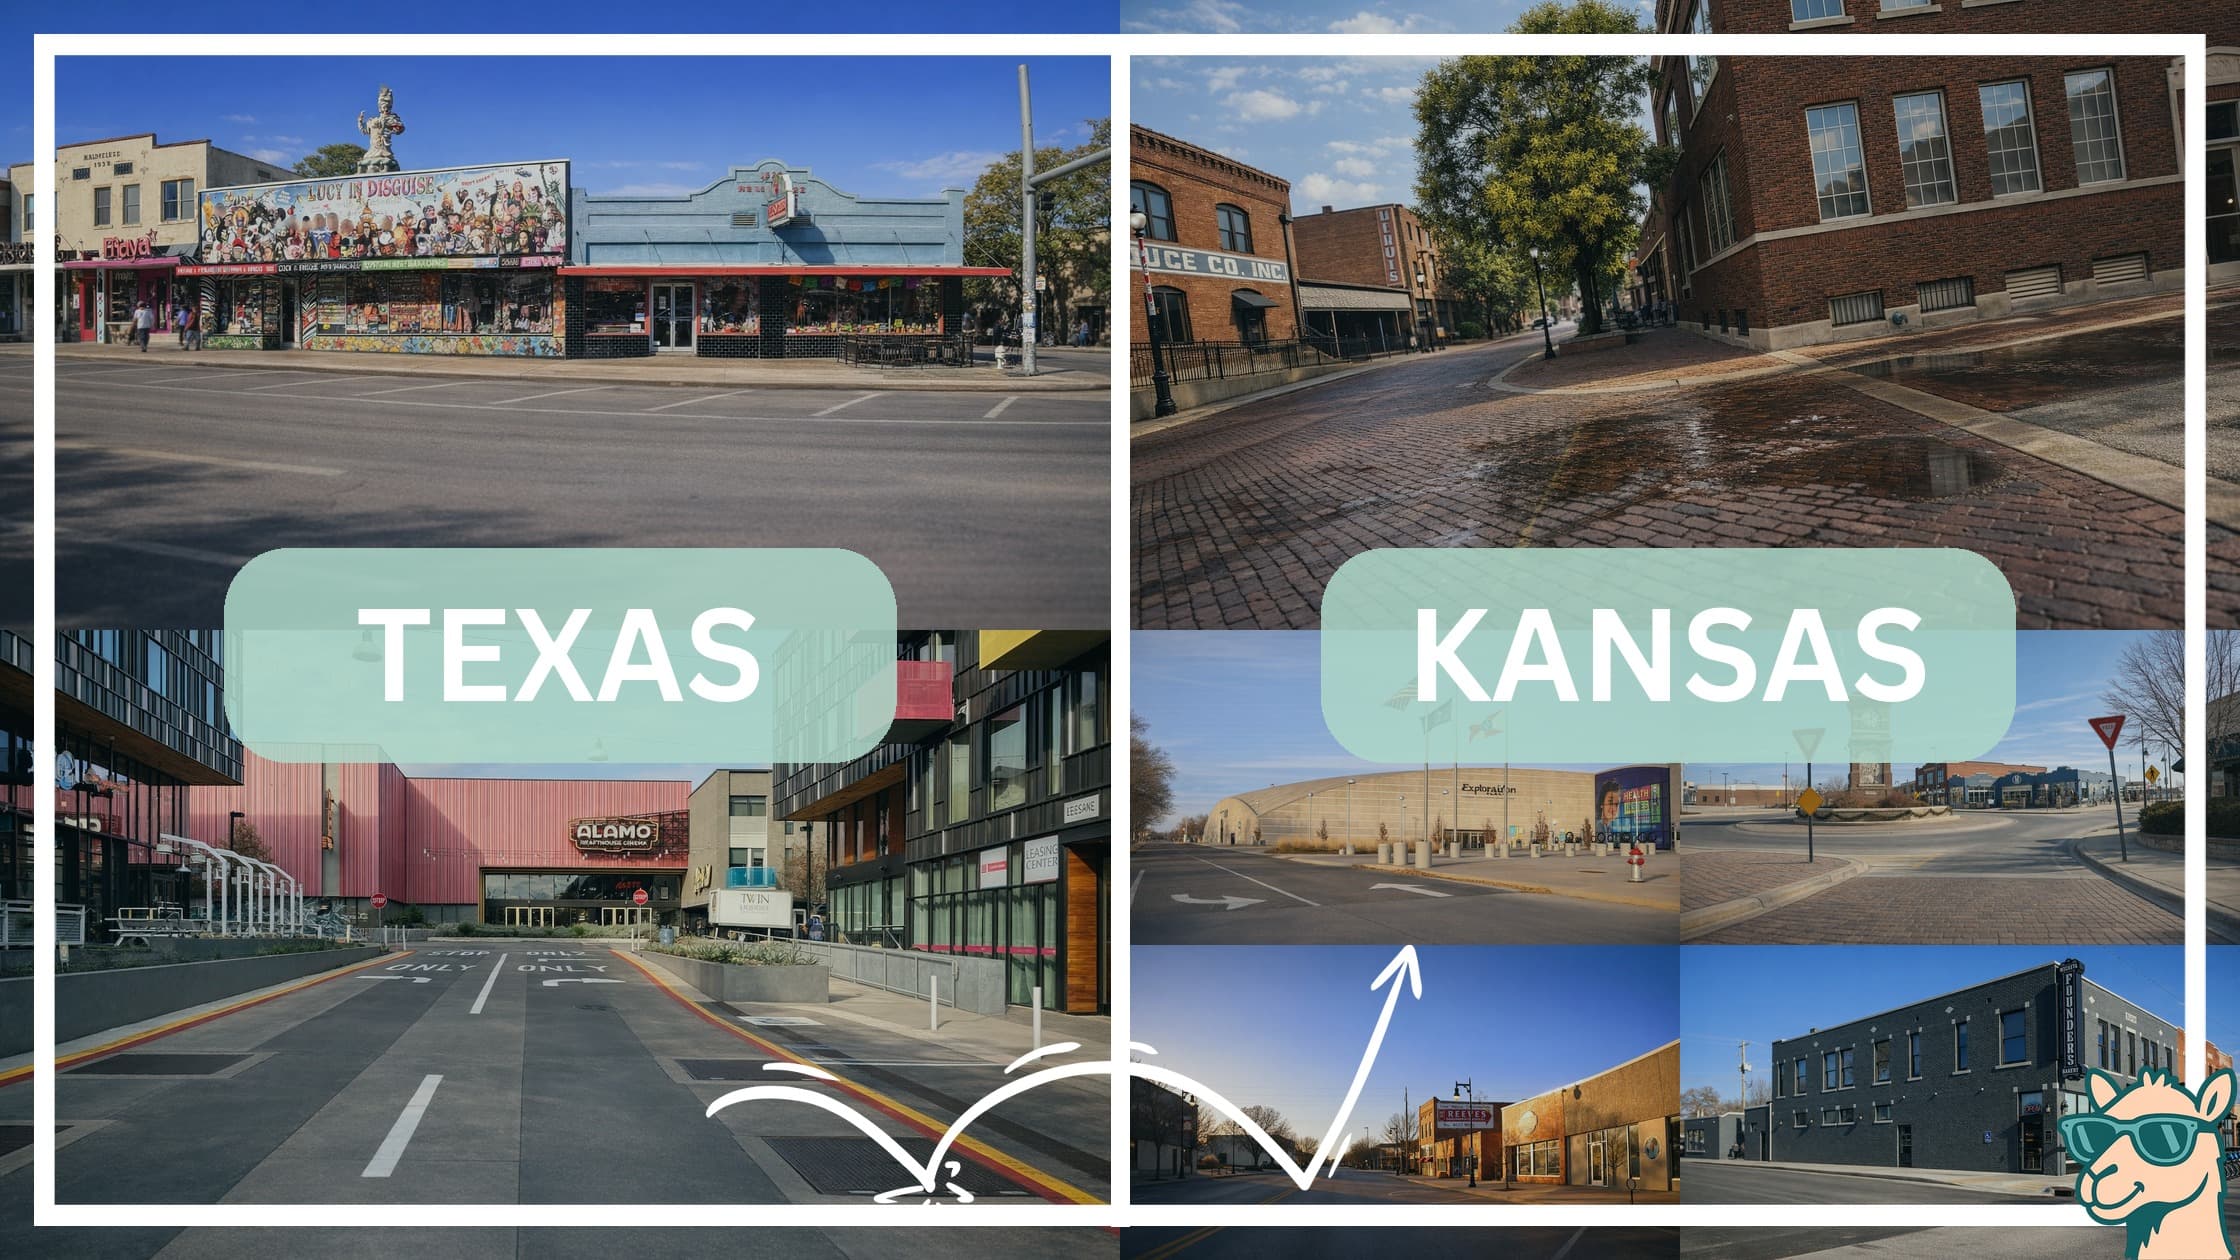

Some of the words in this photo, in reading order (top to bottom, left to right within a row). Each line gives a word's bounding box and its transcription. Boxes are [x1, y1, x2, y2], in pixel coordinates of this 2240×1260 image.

[308, 183, 344, 201] LUCY
[349, 181, 362, 199] IN
[367, 176, 435, 198] DISGUISE
[1207, 255, 1245, 276] CO.
[1252, 261, 1286, 280] INC.
[577, 825, 652, 839] ALAMO
[1025, 843, 1059, 860] LEASING
[1025, 856, 1059, 871] CENTER
[741, 893, 770, 905] TWIN
[383, 963, 478, 972] ONLY
[517, 964, 609, 973] ONLY
[2065, 973, 2075, 1066] FOUNDERS
